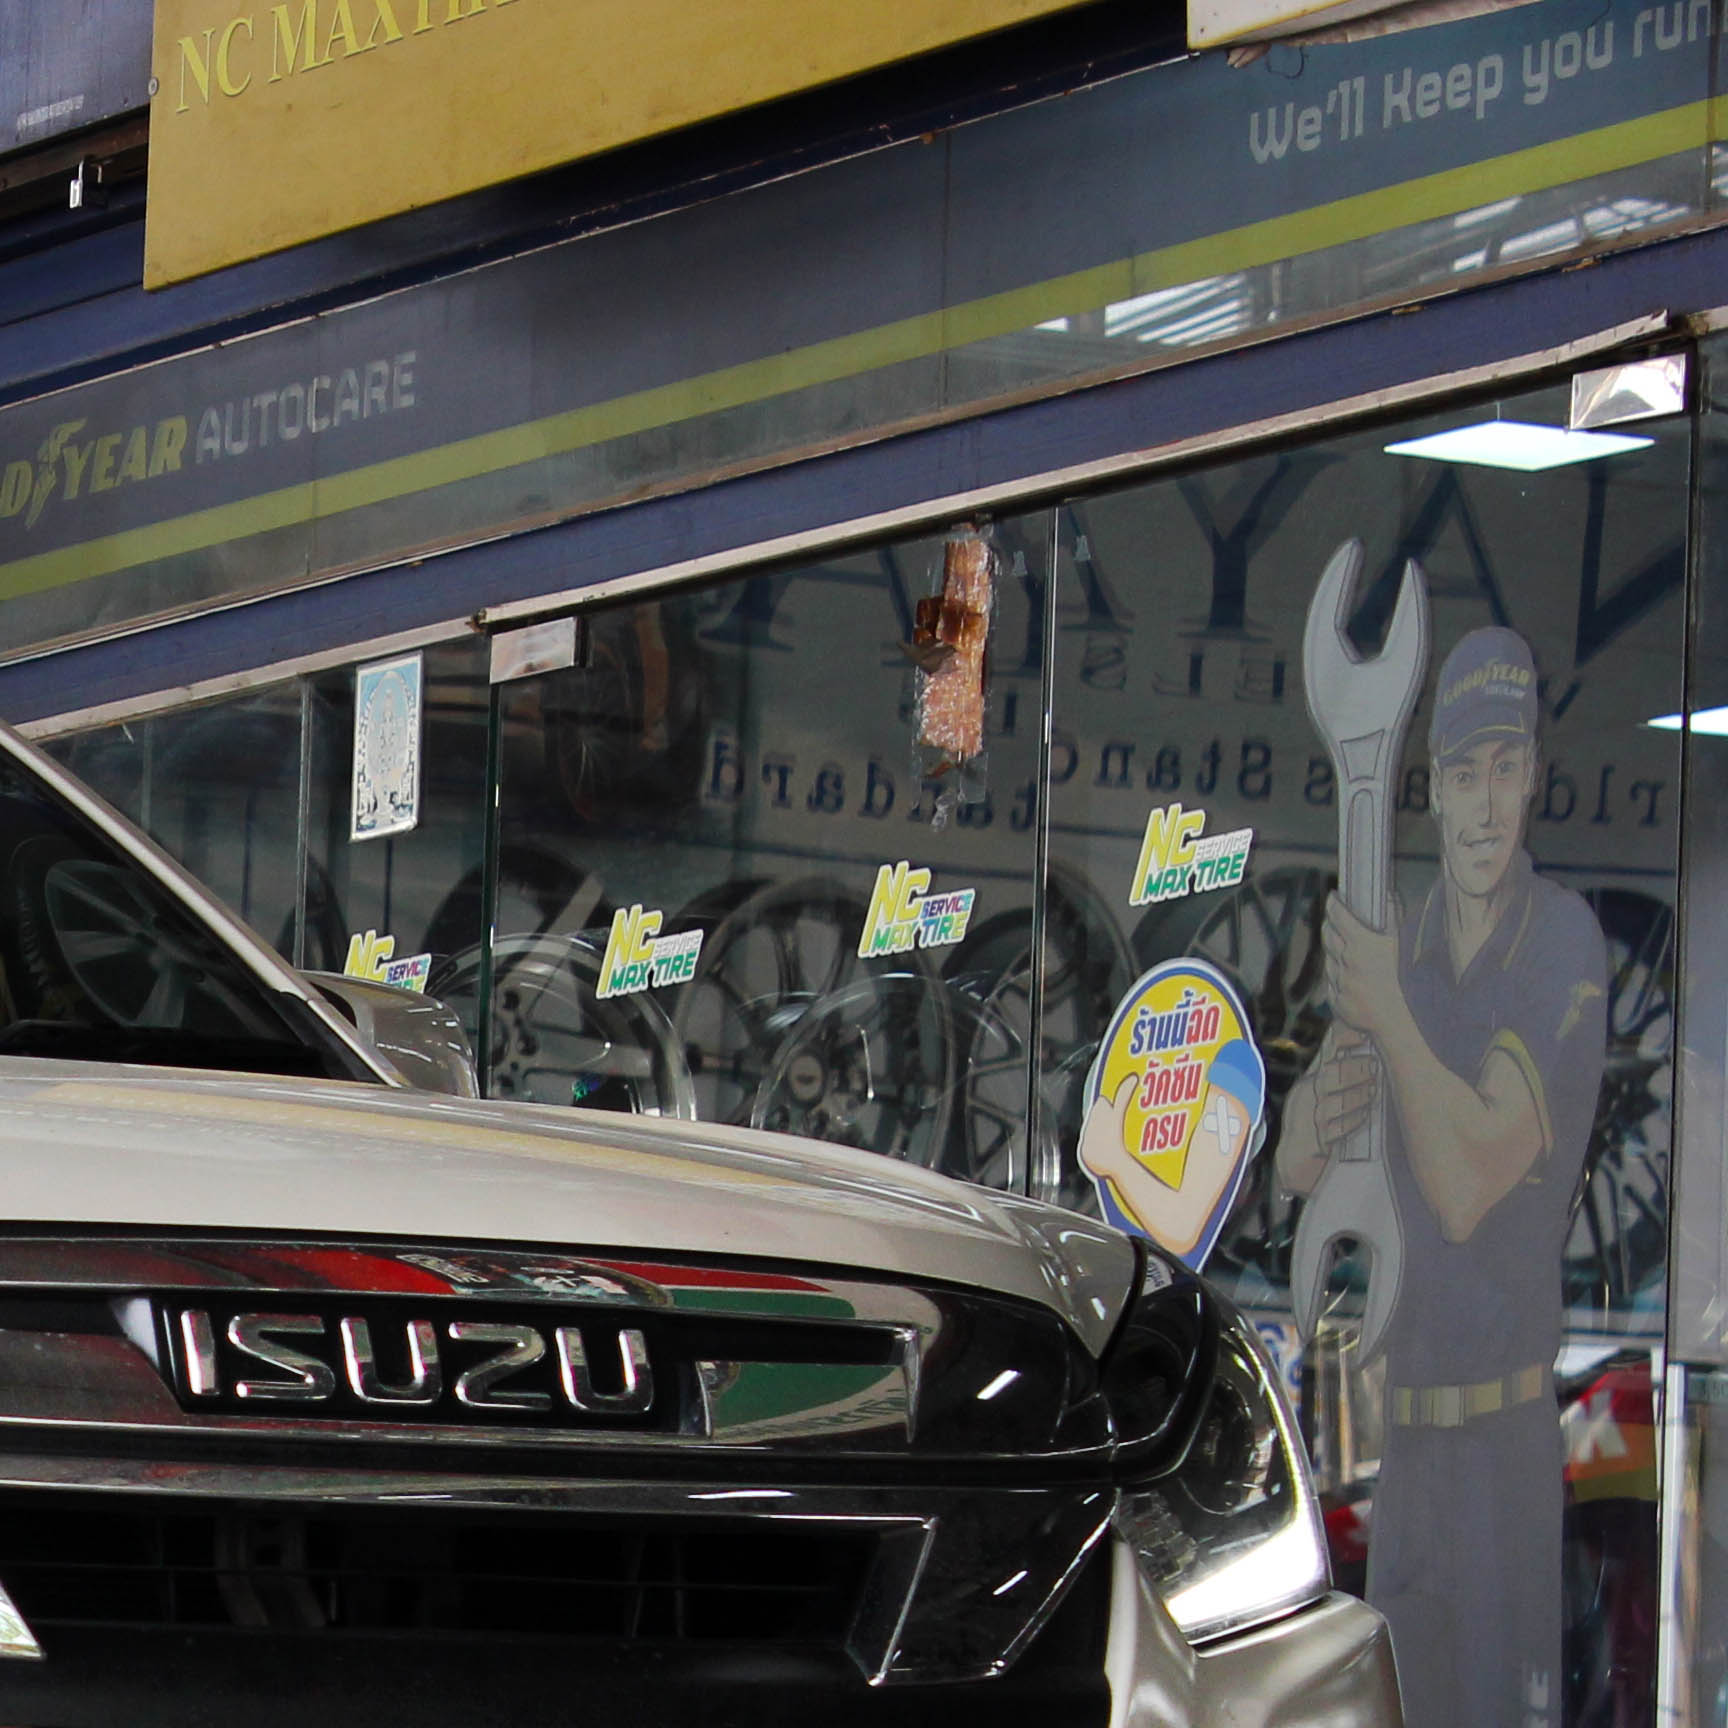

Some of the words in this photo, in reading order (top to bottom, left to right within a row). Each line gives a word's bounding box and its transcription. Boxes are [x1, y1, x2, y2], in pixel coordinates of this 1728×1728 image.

[176, 17, 253, 113] NC
[1249, 76, 1365, 165] We'll
[1382, 53, 1504, 130] Keep
[1522, 20, 1614, 106] you
[196, 351, 417, 462] AUTOCARE
[1131, 804, 1205, 905] NC
[1143, 865, 1193, 900] MAX
[1193, 853, 1246, 889] TIRE
[860, 861, 931, 957] NC
[919, 892, 974, 920] SERVICE
[872, 923, 916, 953] MAX
[919, 911, 968, 944] TIRE
[344, 929, 395, 983] NC
[386, 955, 429, 983] SERVICE
[598, 904, 663, 998] NC
[608, 962, 651, 995] MAX
[651, 950, 699, 986] TIRE
[1131, 989, 1221, 1054] ร้านนี้ฉีด
[1141, 1053, 1203, 1108] วัคซีน
[1142, 1112, 1187, 1152] ครบ
[178, 1306, 655, 1417] ISUZU
